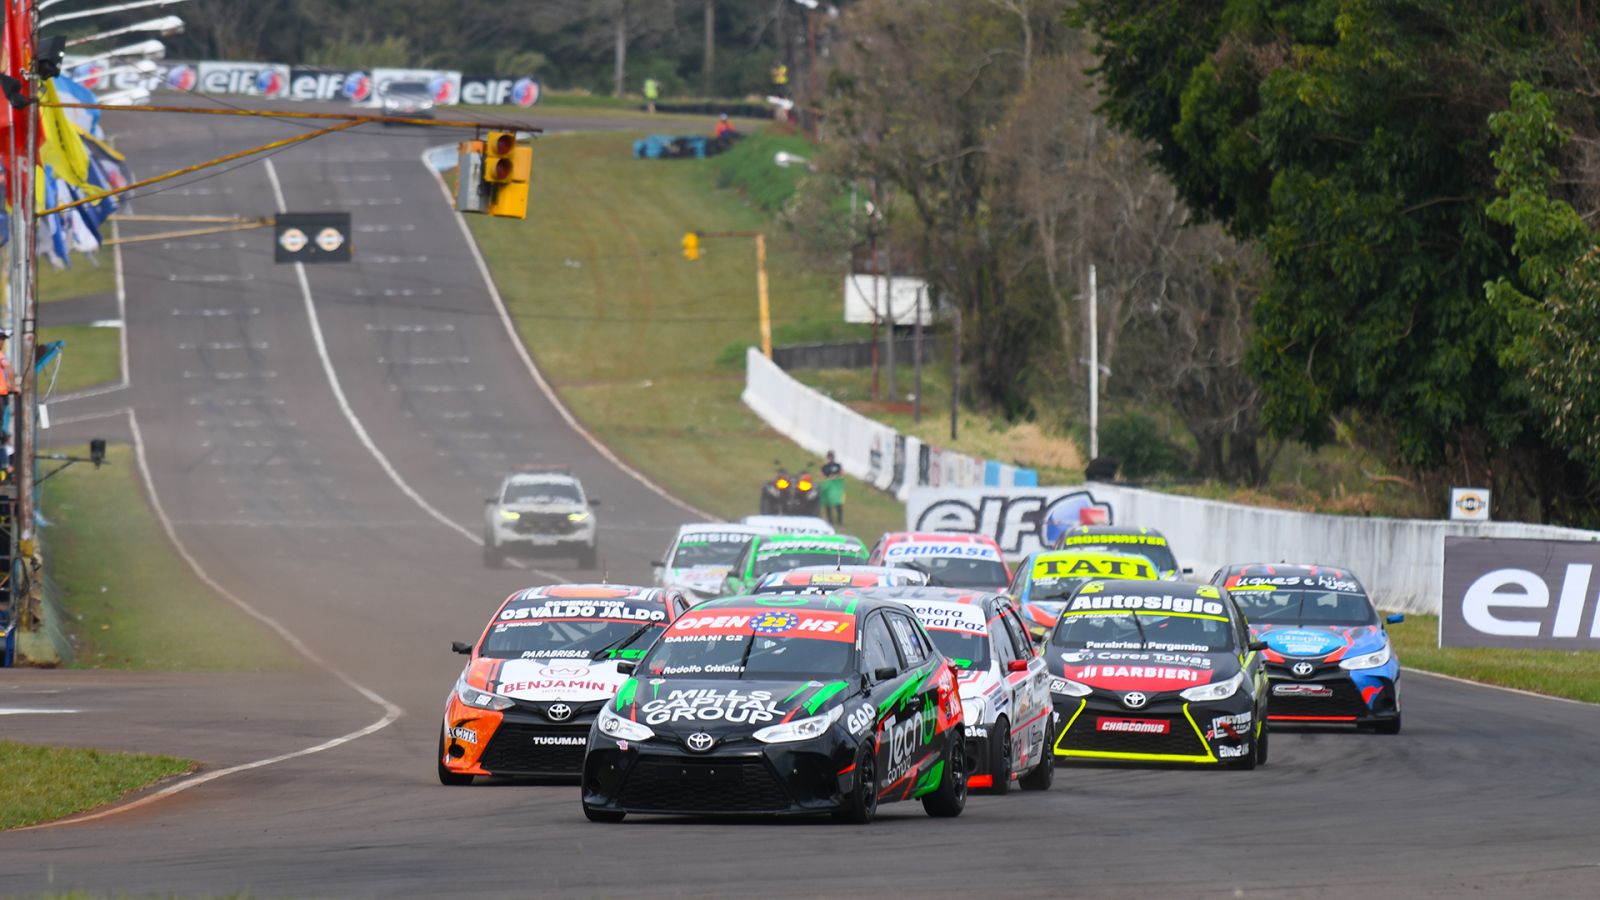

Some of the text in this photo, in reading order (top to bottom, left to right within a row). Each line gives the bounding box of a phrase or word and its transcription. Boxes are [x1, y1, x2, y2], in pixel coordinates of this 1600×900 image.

[205, 71, 258, 95] elf
[292, 73, 344, 100] elf
[462, 79, 513, 105] elf
[916, 495, 1048, 555] elf
[887, 543, 994, 558] CRIMASE
[1036, 558, 1149, 578] TATI
[1070, 594, 1224, 615] Autosiglo
[1462, 564, 1600, 638] el
[500, 606, 666, 621] OSVALDO JALDO
[674, 615, 849, 634] OPEN 25 HS!
[954, 619, 986, 631] Paz
[664, 635, 723, 643] DAMIANI
[1086, 641, 1210, 652] Parabrisa Pergamino
[521, 650, 592, 659] PARABRISAS
[1097, 652, 1151, 661] Ceres
[663, 664, 702, 675] Rodolfo
[1102, 666, 1198, 682] BARBIERI
[668, 689, 773, 701] MILLS
[641, 697, 787, 716] CAPITAL
[645, 707, 774, 725] GROUP
[1102, 721, 1165, 733] CHASCOMUS
[533, 736, 587, 746] TUCUMAN
